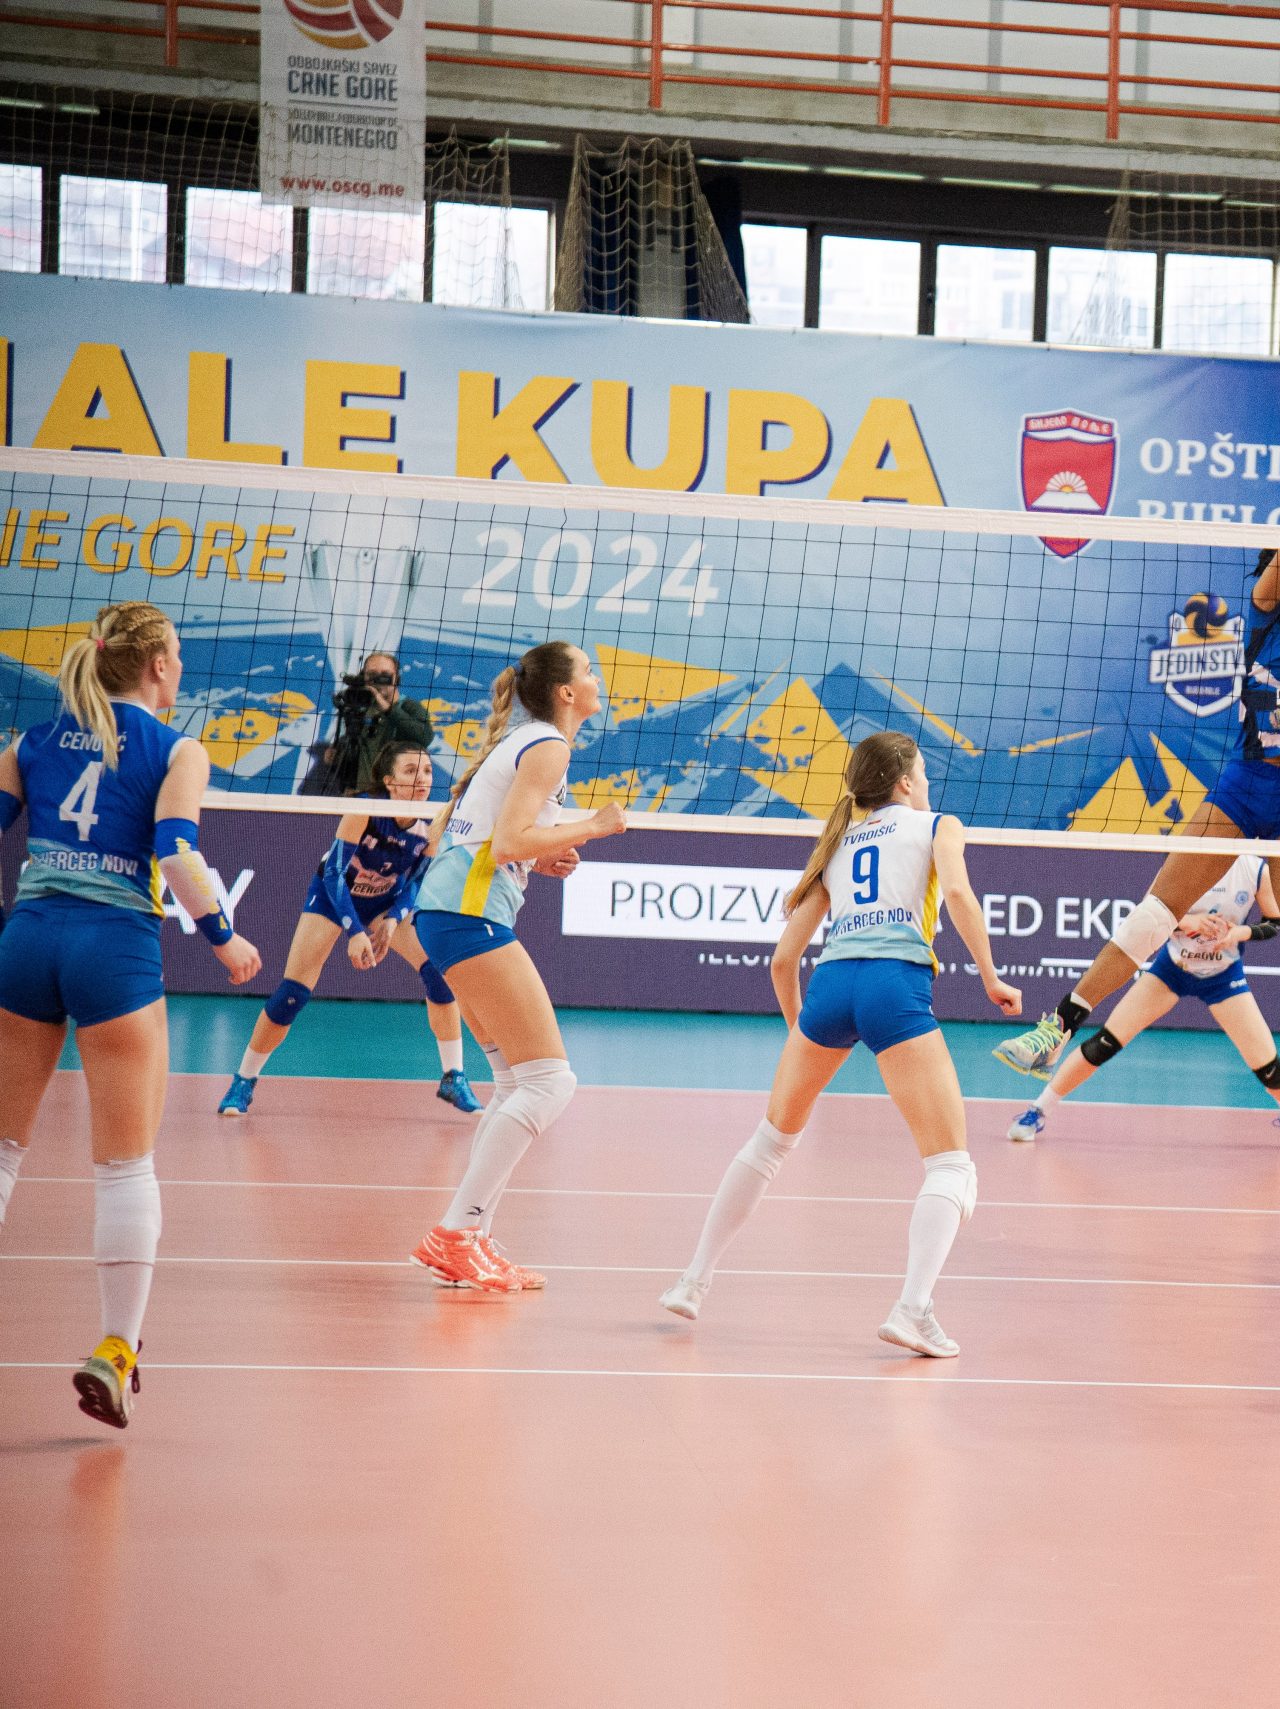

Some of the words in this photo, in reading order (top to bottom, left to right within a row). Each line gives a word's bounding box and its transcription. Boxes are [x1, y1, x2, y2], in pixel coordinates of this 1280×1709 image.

[288, 55, 360, 73] ODBOJKAŠKI
[288, 70, 340, 97] CRNE
[346, 76, 398, 101] GORE
[288, 123, 398, 150] MONTENEGRO
[280, 177, 405, 196] www.oscg.me
[0, 336, 406, 474] ALE
[456, 370, 948, 508] KUPA
[82, 513, 296, 583] GORE
[462, 526, 720, 617] 2024
[1156, 645, 1243, 677] JEDINSTV
[59, 760, 103, 842] 4
[101, 853, 138, 876] NOVI
[852, 845, 880, 905] 9
